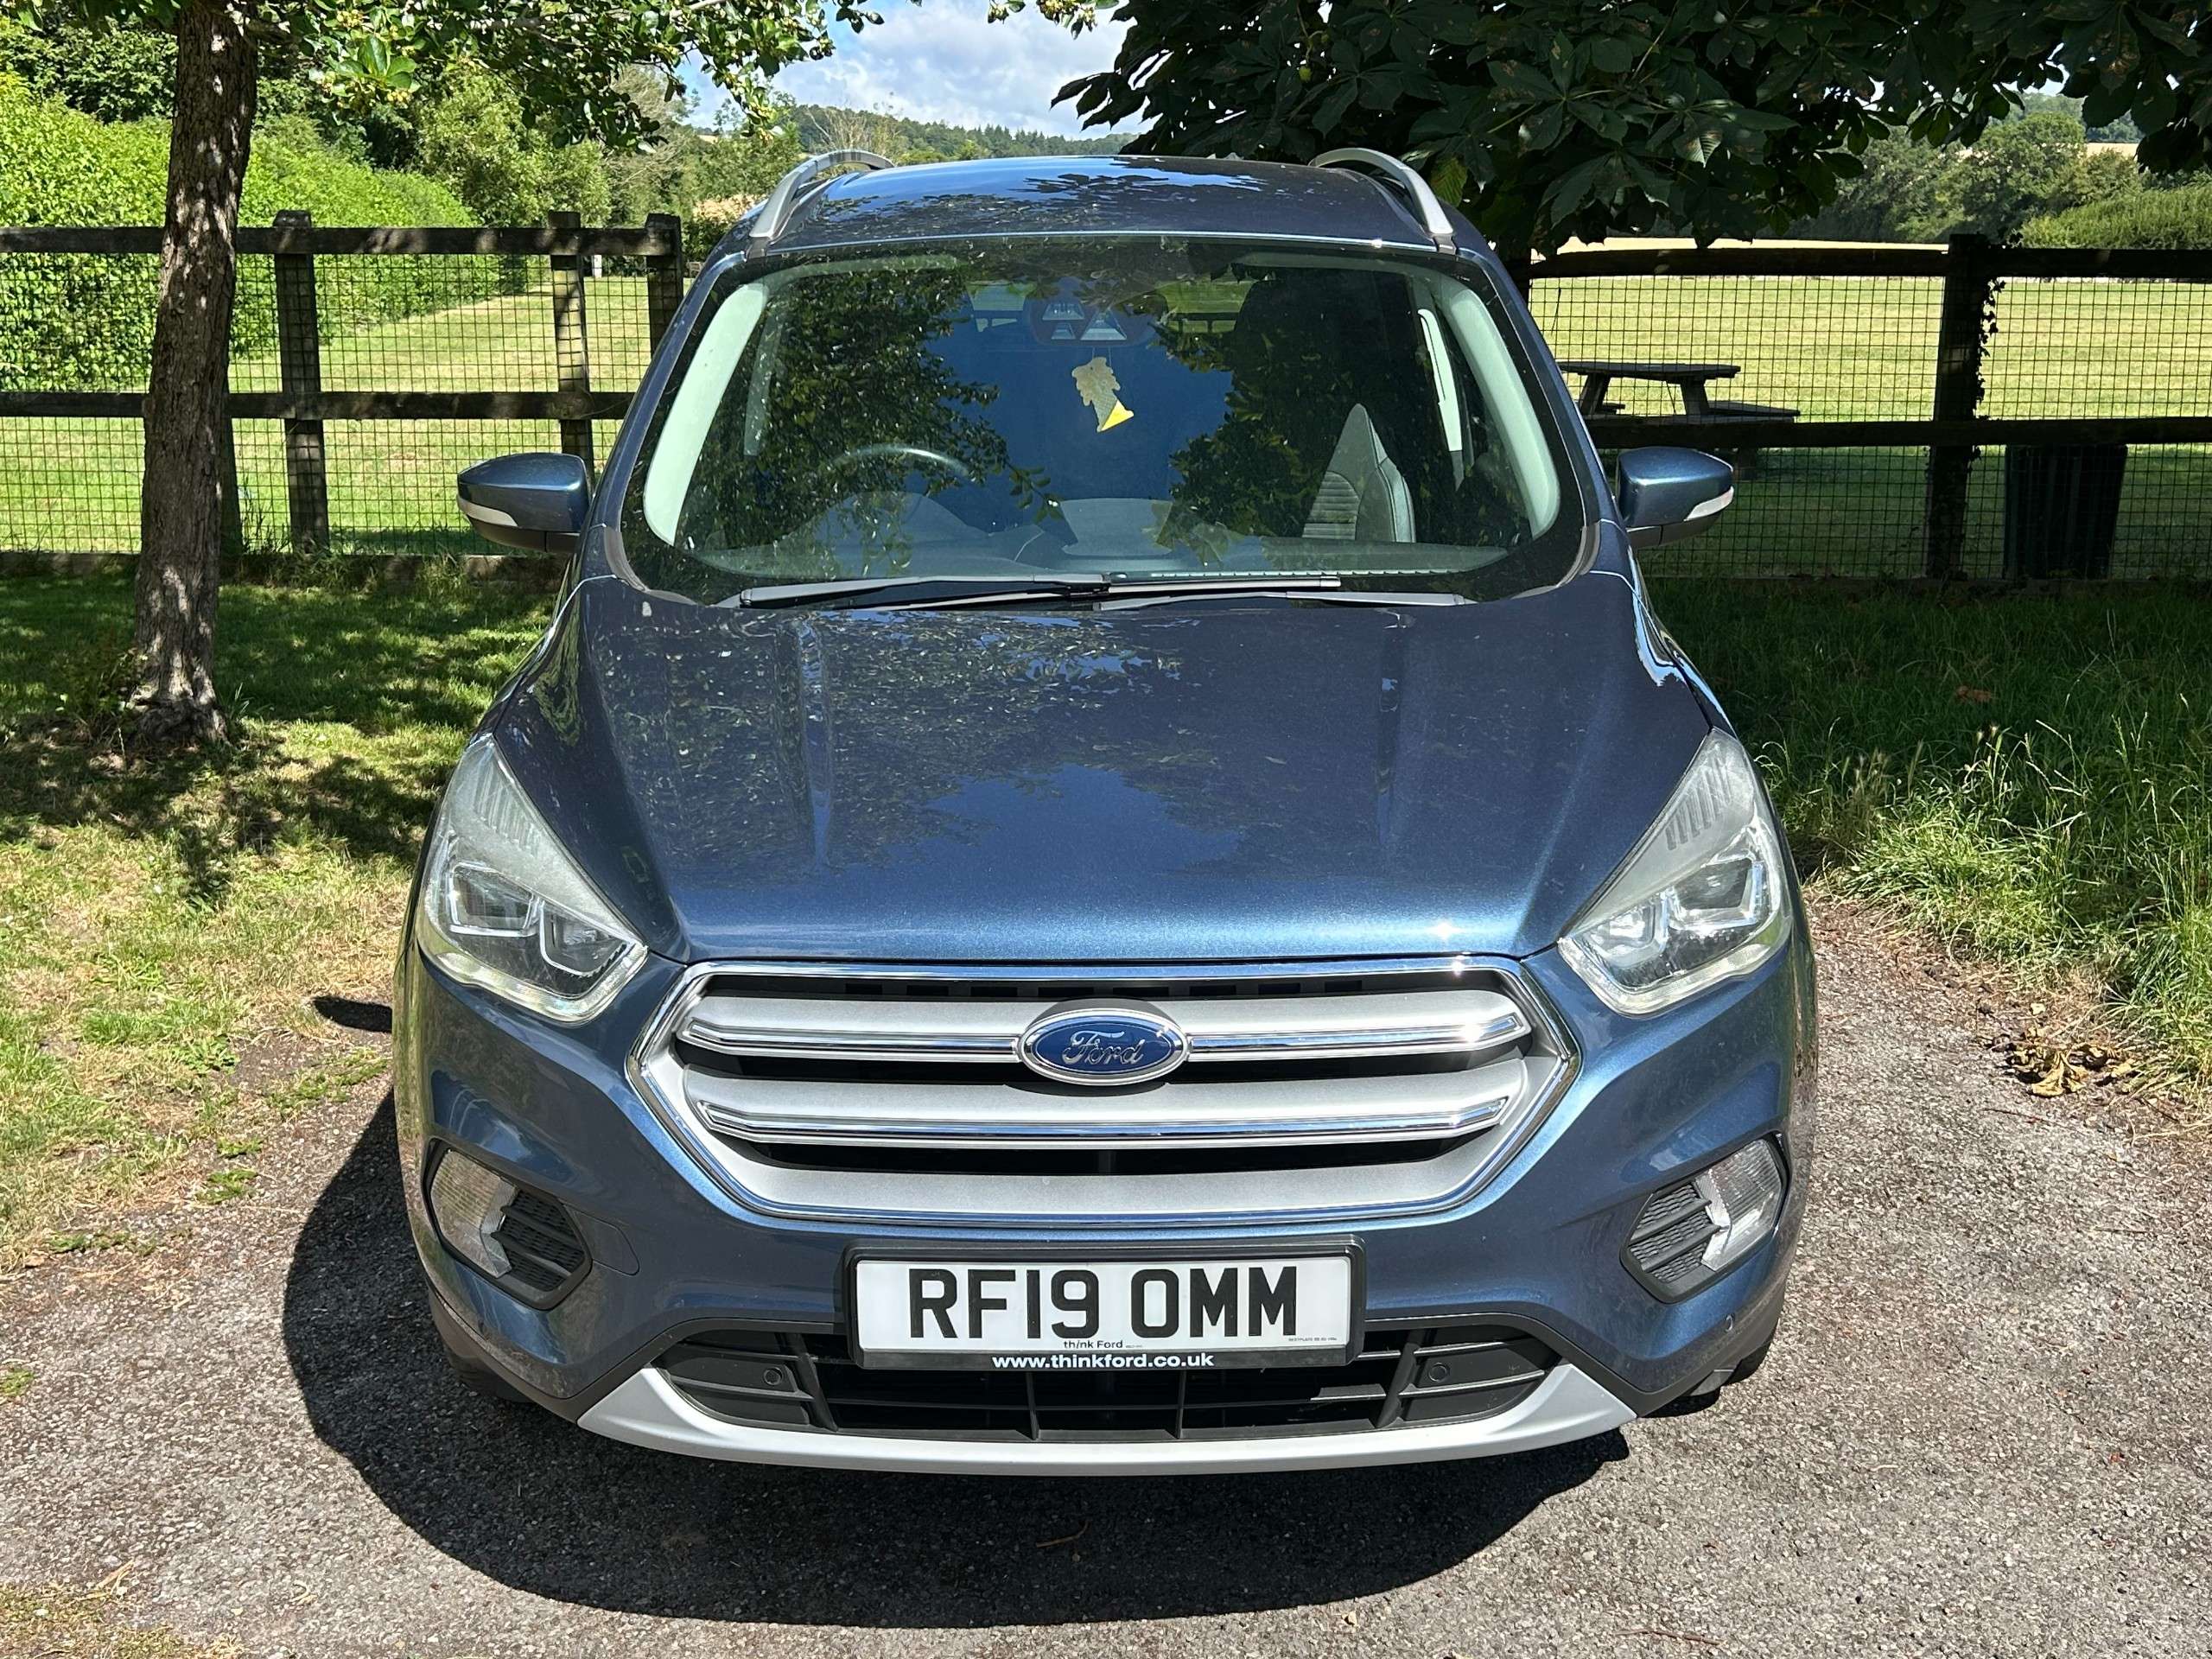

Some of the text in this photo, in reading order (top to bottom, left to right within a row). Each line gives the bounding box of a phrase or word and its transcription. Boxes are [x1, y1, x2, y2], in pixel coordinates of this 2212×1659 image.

[1062, 1031, 1146, 1065] Ford
[909, 1267, 1296, 1338] RF19 OMM
[992, 1352, 1215, 1369] www.thinkford.co.uk
